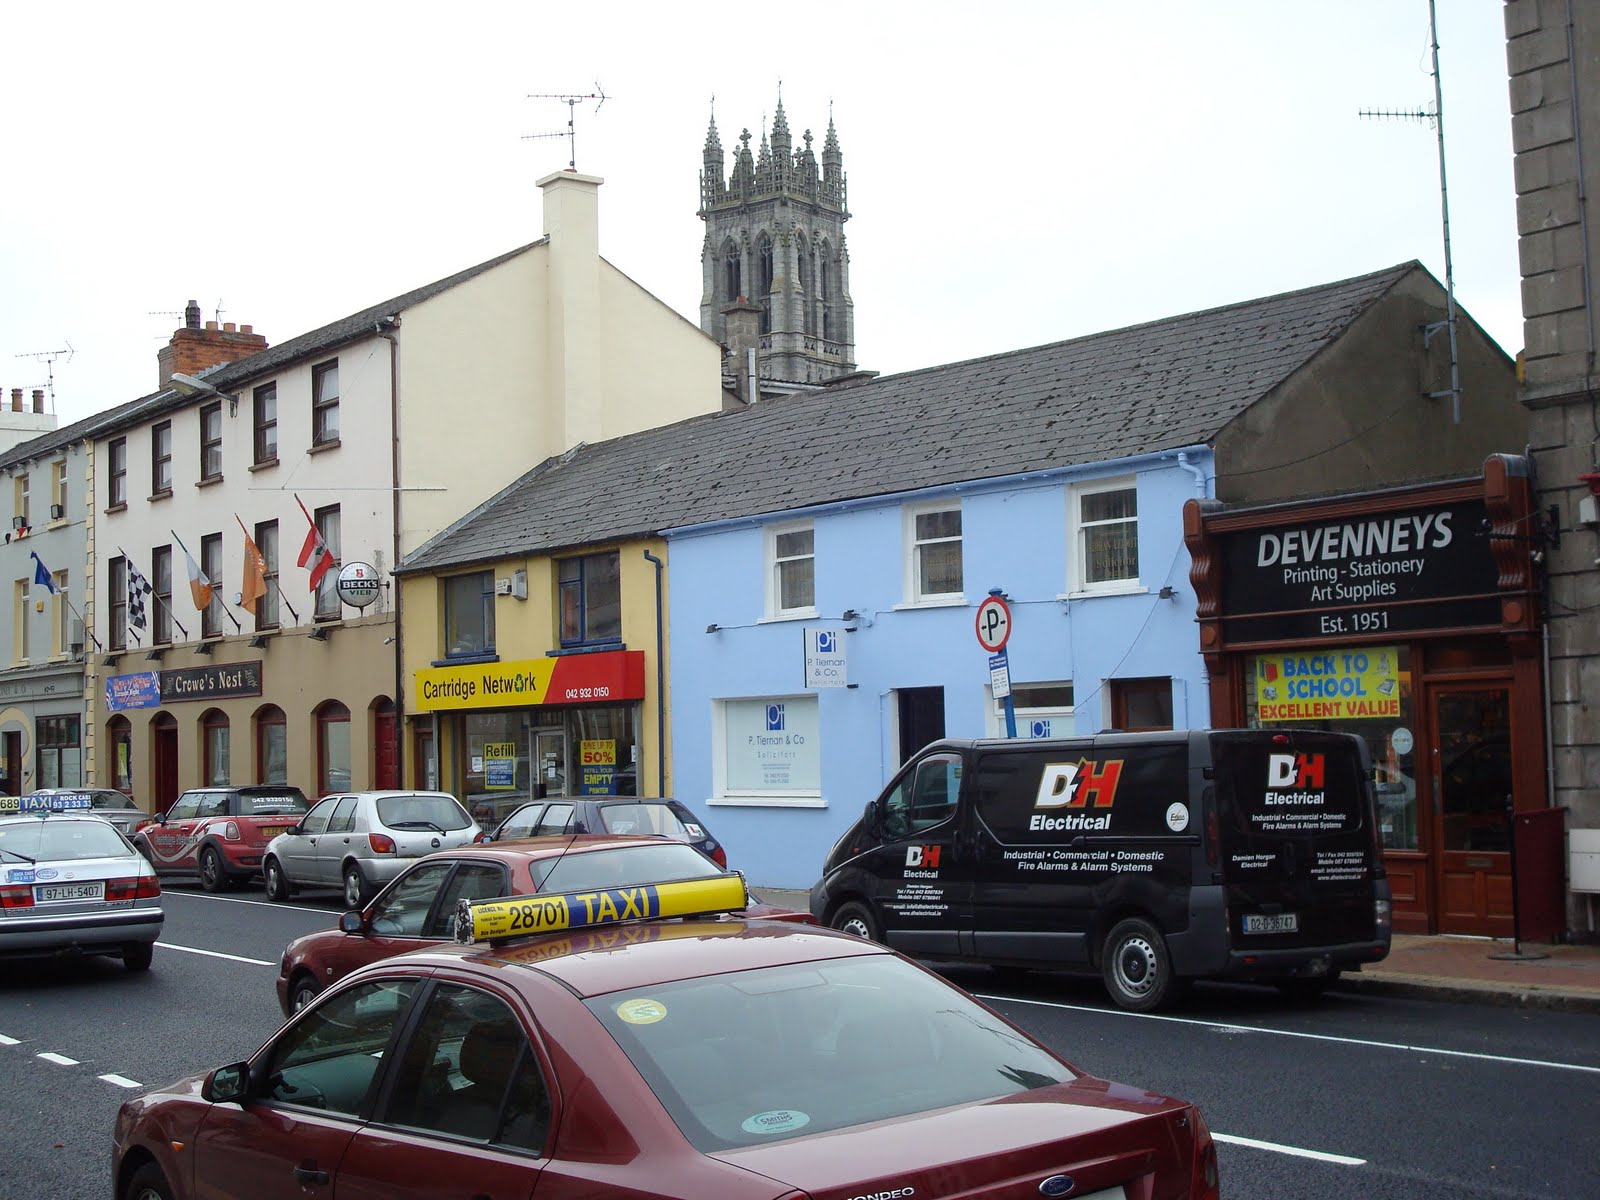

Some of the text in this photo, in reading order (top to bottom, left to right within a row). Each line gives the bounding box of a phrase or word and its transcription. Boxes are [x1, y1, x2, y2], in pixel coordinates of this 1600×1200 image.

[1258, 512, 1452, 567] DEVENNEYS
[1284, 564, 1338, 584] Printing
[1350, 557, 1425, 578] Stationery
[342, 580, 378, 589] BECK'S
[1311, 580, 1397, 602] Art Supplies
[986, 608, 999, 641] P
[1321, 612, 1389, 634] Est. 1951
[815, 658, 846, 667] Tiernan
[1284, 653, 1369, 678] BACK TO
[815, 668, 821, 677] &
[175, 673, 215, 693] Crowe's
[219, 670, 242, 689] Nest
[424, 672, 536, 700] Cartridge Network
[566, 687, 609, 699] 042 932 0150
[1287, 678, 1367, 699] SCHOOL
[1259, 699, 1399, 720] EXCELLENT VALUE
[757, 735, 784, 746] Tiernan
[785, 735, 791, 745] &
[793, 734, 805, 745] Co
[486, 744, 514, 757] Refill
[583, 751, 613, 763] 50%
[584, 774, 613, 785] EMPTY
[22, 796, 52, 809] TAXI
[53, 801, 63, 809] 93
[72, 800, 82, 808] 33
[1265, 792, 1325, 805] Electrical
[1030, 813, 1112, 831] Electrical
[1320, 822, 1342, 830] Systems
[1003, 850, 1164, 861] Industrial Commercial Domestic
[1255, 854, 1276, 862] Horgan
[1017, 861, 1153, 872] Fire Alarms & Alarm Systems
[1241, 861, 1268, 869] Electrical
[903, 870, 939, 879] Electrical
[46, 886, 100, 899] 97-LH-5407
[478, 906, 497, 914] LICENCE
[576, 887, 650, 924] TAXI
[509, 901, 565, 930] 28701
[760, 1114, 793, 1125] SMITHS
[847, 1187, 915, 1200] NDEO
